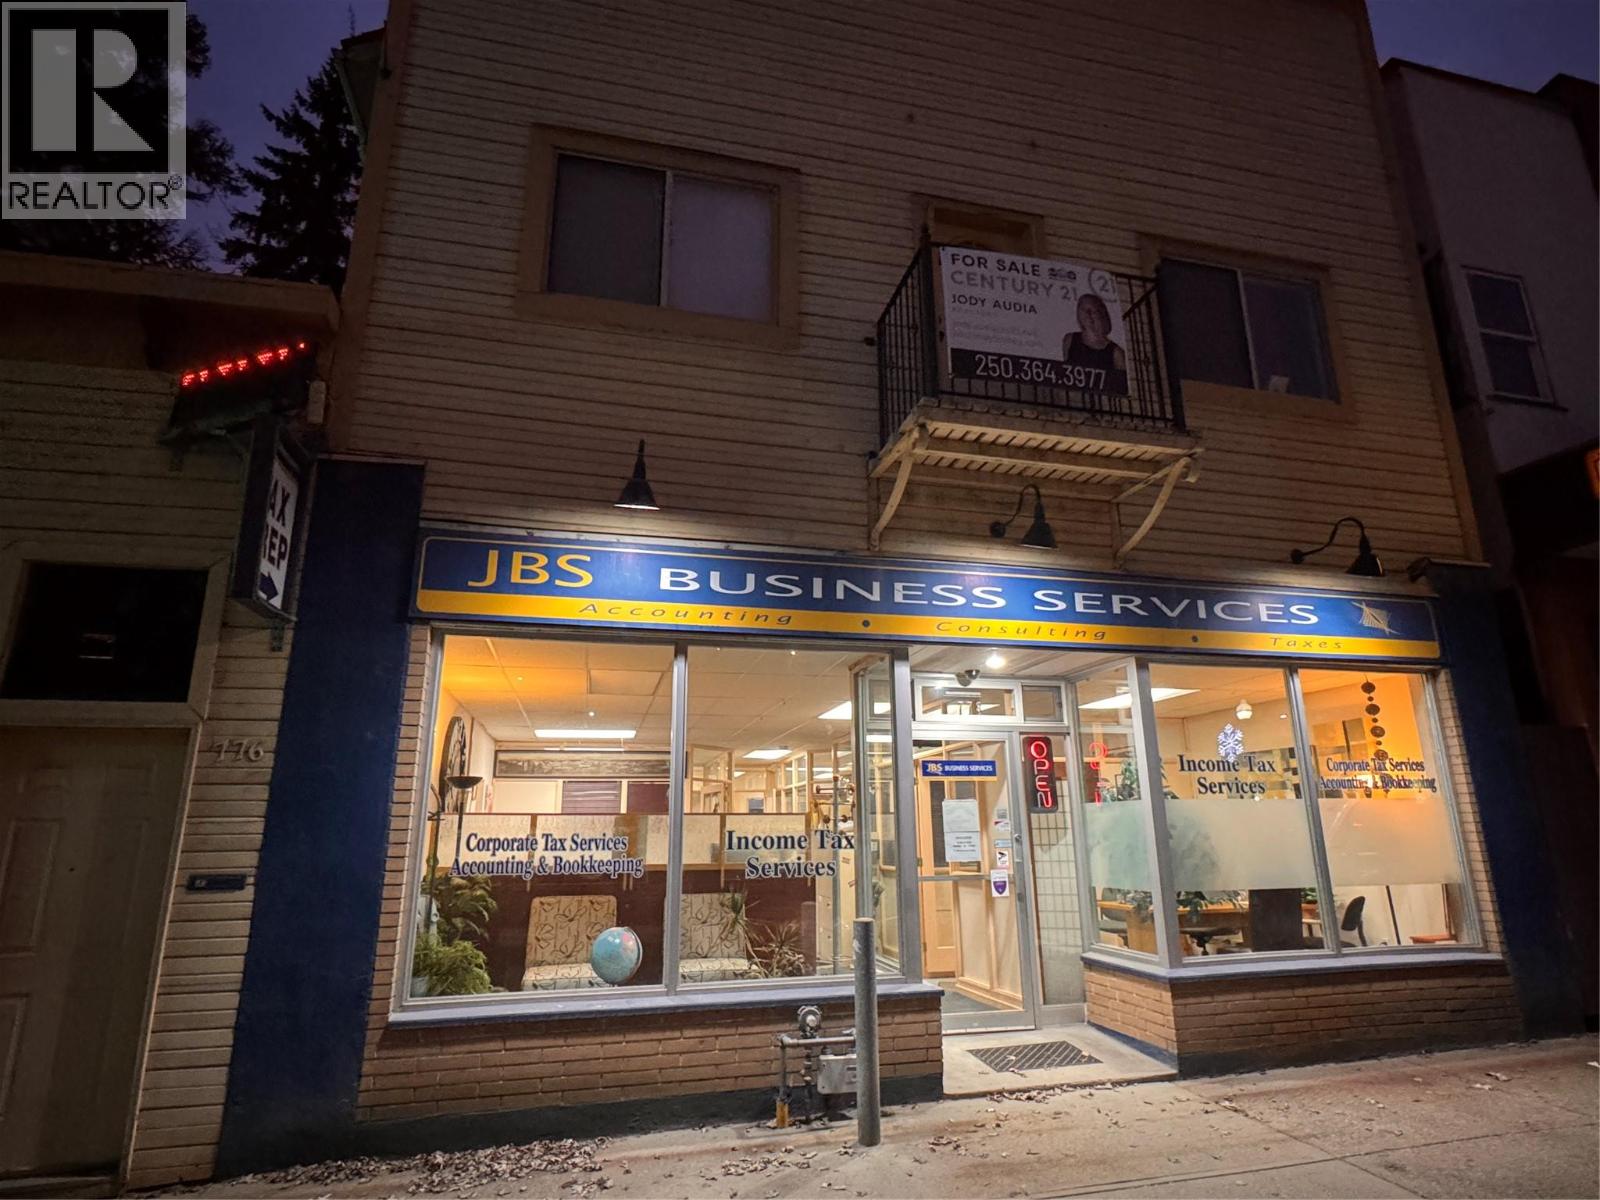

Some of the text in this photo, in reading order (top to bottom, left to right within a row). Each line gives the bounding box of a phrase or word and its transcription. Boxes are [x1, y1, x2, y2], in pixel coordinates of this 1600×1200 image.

[951, 253, 988, 269] FOR
[997, 259, 1040, 277] SALE
[951, 271, 1053, 297] CENTURY
[1060, 286, 1078, 301] 21
[951, 294, 986, 307] JODY
[993, 300, 1038, 314] AUDIA
[975, 354, 1106, 390] 250.364.3977
[468, 550, 1320, 625] JBS BUSINESS SERVICES
[579, 603, 1344, 650] Accounting Consulting Taxes
[926, 763, 943, 772] JBS
[1031, 740, 1052, 808] OPEN
[1178, 754, 1276, 772] Income Tax
[1327, 758, 1425, 774] Corporate Tax Services
[1197, 778, 1266, 795] Services
[466, 833, 627, 855] Corporate Tax Services
[726, 830, 855, 850] Income Tax
[450, 856, 644, 880] Accounting & Bookkeeping
[745, 857, 836, 878] Services
